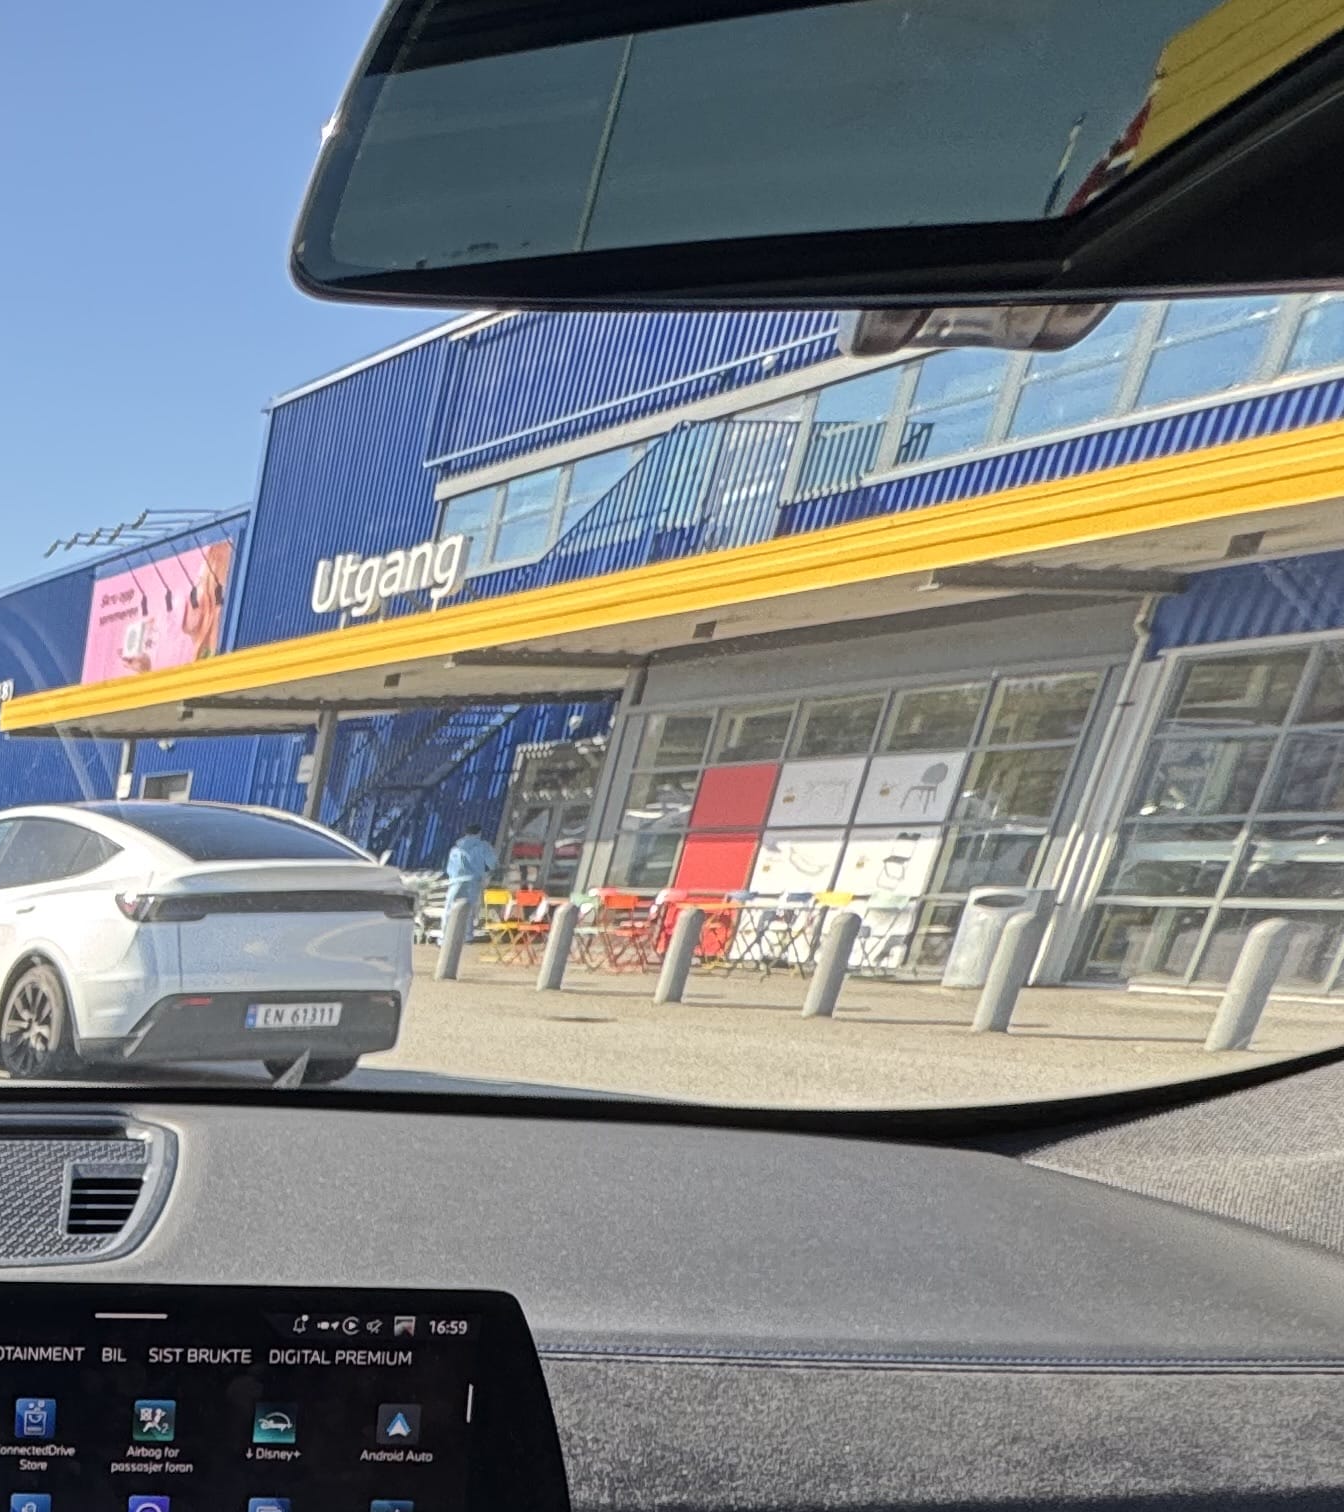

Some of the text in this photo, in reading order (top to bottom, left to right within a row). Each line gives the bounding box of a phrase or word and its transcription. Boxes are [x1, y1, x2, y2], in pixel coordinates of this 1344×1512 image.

[312, 533, 465, 618] Utgang
[263, 1007, 333, 1024] EN 61311
[428, 1320, 468, 1335] 16:59
[101, 1348, 127, 1363] BIL
[148, 1349, 252, 1364] SIST BRUKTE
[269, 1351, 413, 1366] DIGITAL PREMIUM
[126, 1445, 179, 1460] Airbag for
[256, 1448, 301, 1462] Disney+
[360, 1449, 433, 1462] Android Auto
[19, 1459, 47, 1471] Store
[111, 1461, 194, 1475] passasjer foran
